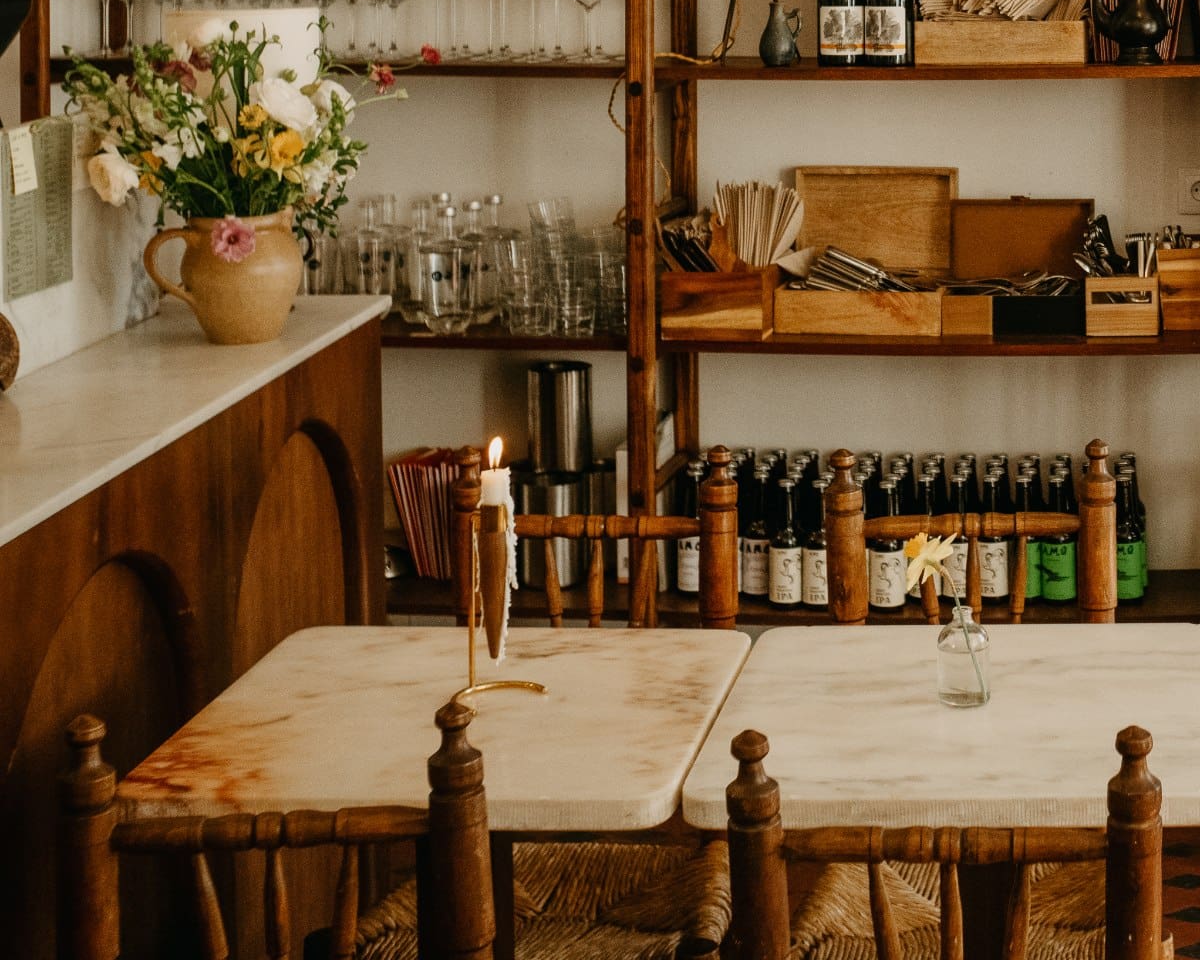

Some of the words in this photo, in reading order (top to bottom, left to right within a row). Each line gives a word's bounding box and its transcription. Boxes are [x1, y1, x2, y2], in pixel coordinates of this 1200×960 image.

[776, 592, 793, 601] IPA
[809, 593, 827, 602] IPA
[875, 596, 892, 604] IPA
